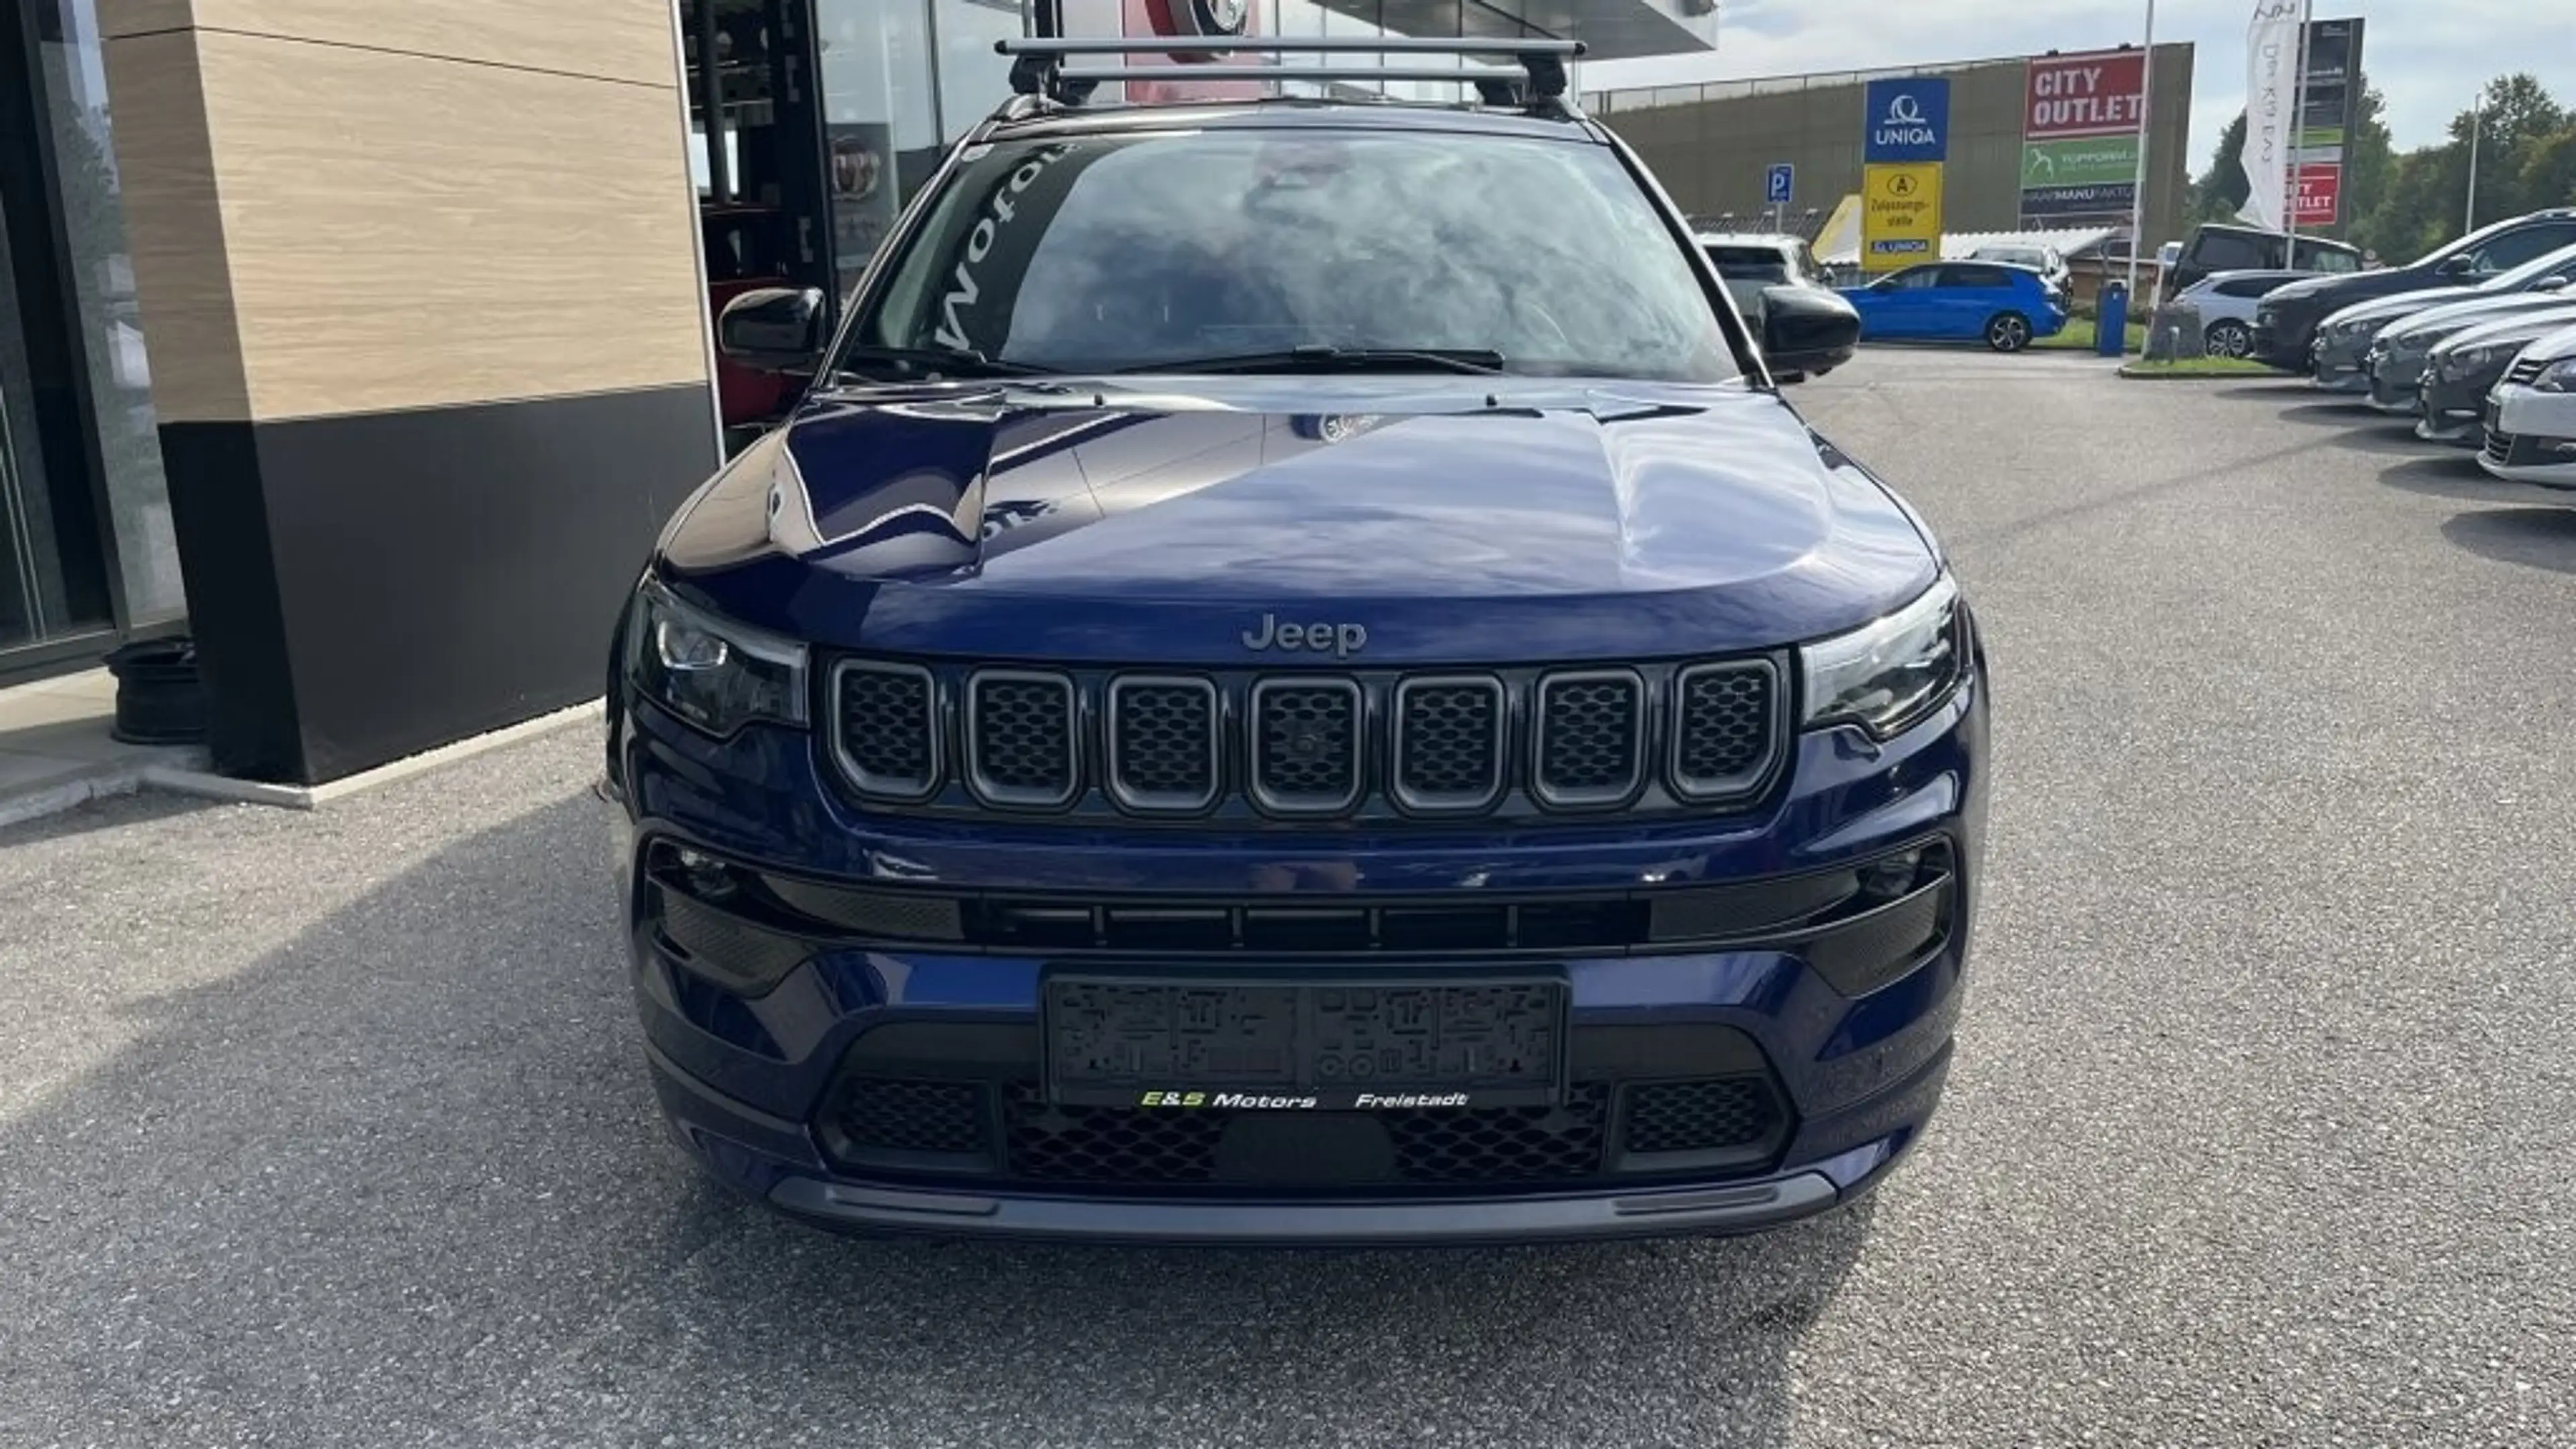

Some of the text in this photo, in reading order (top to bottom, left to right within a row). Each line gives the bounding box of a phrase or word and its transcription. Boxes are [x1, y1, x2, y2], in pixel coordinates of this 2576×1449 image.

[2035, 68, 2102, 97] CITY
[2033, 93, 2145, 125] OUTLET
[1875, 127, 1936, 145] UNIQA
[1772, 174, 1784, 197] P
[1242, 613, 1367, 656] Jeep
[1141, 1091, 1471, 1108] E&S Motors Freistadt
